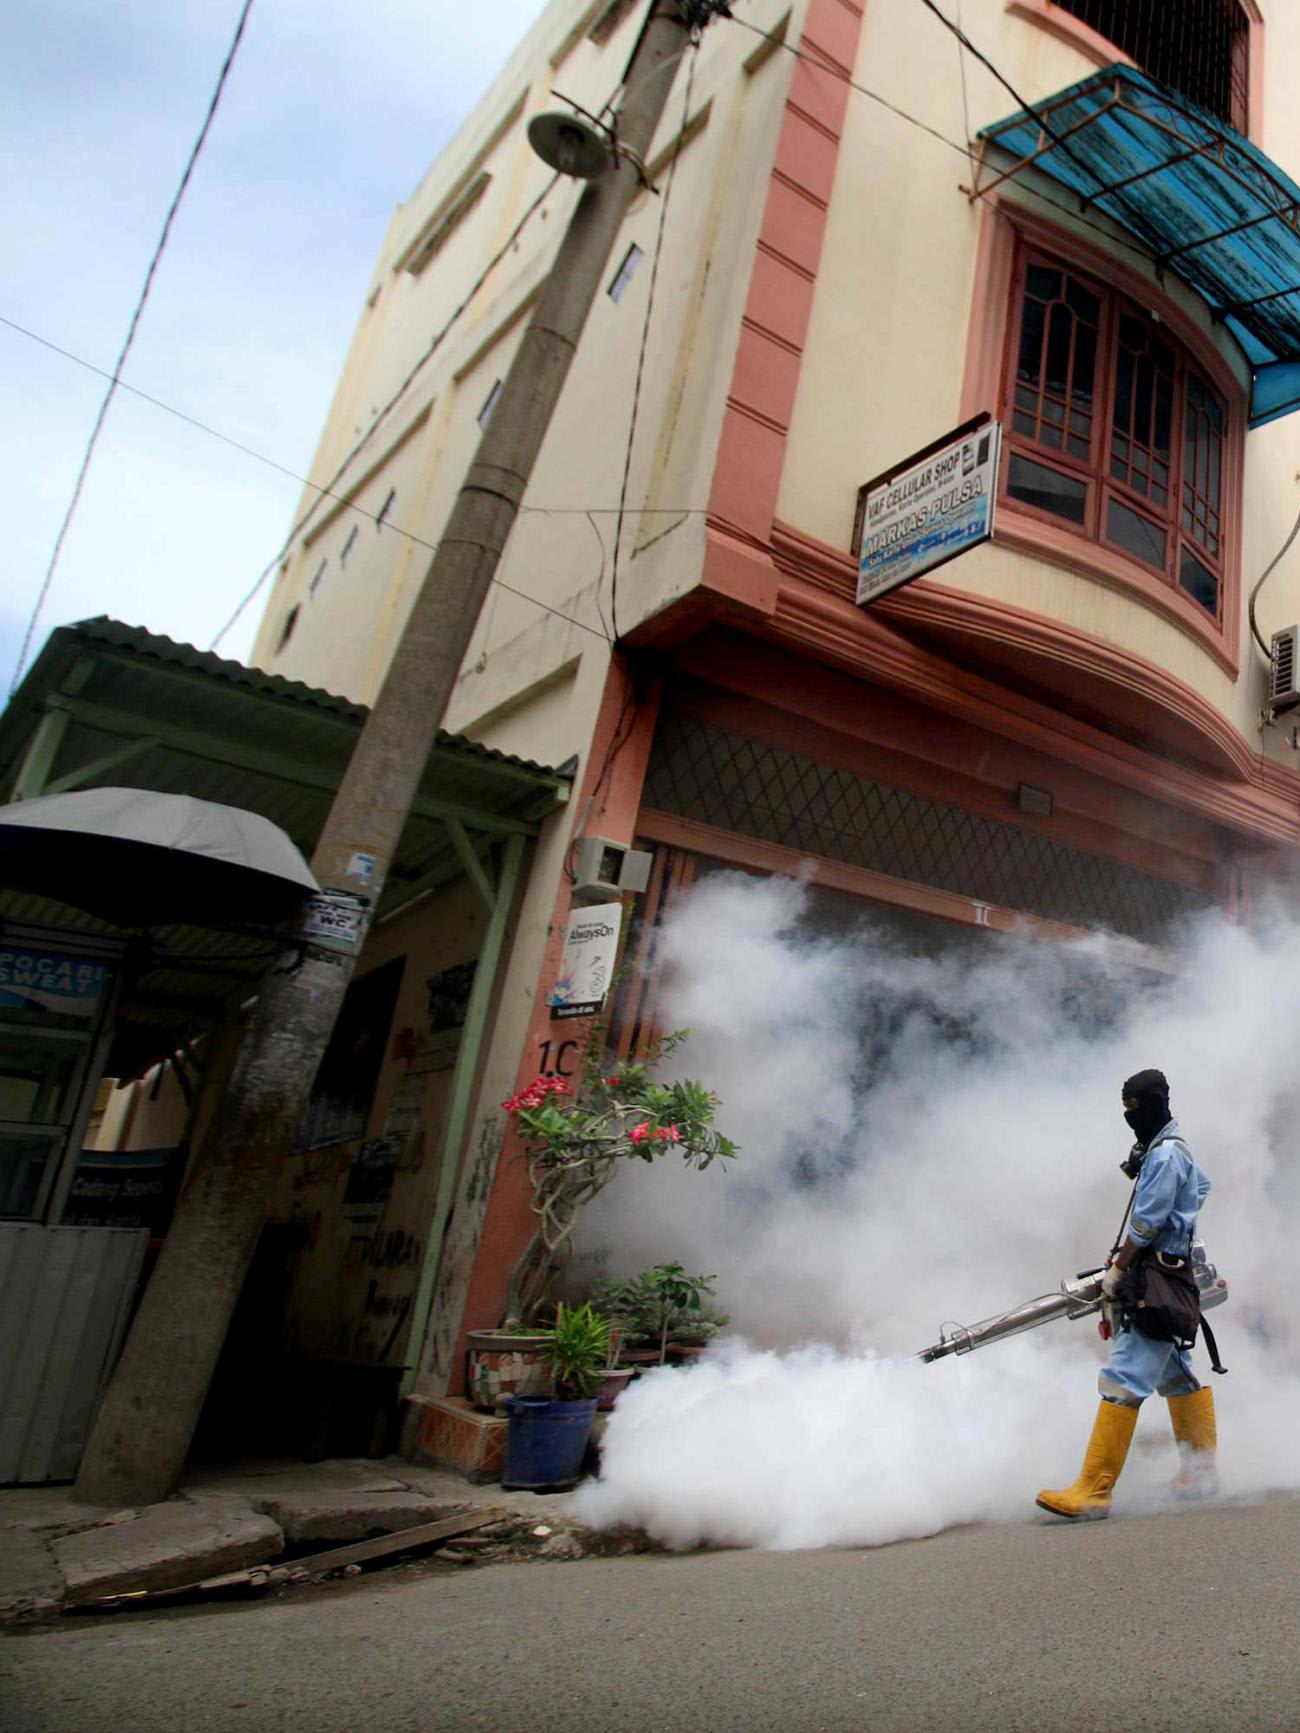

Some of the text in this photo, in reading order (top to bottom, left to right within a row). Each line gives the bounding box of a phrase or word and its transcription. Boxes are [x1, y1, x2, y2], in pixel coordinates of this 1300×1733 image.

[886, 468, 933, 509] CELLULAR
[934, 451, 960, 480] SHOP
[867, 475, 983, 557] MARKAS PULSA
[320, 916, 346, 928] WC
[569, 925, 614, 941] AlwaysOn
[0, 952, 104, 980] POCARI
[0, 966, 92, 992] SWEAT
